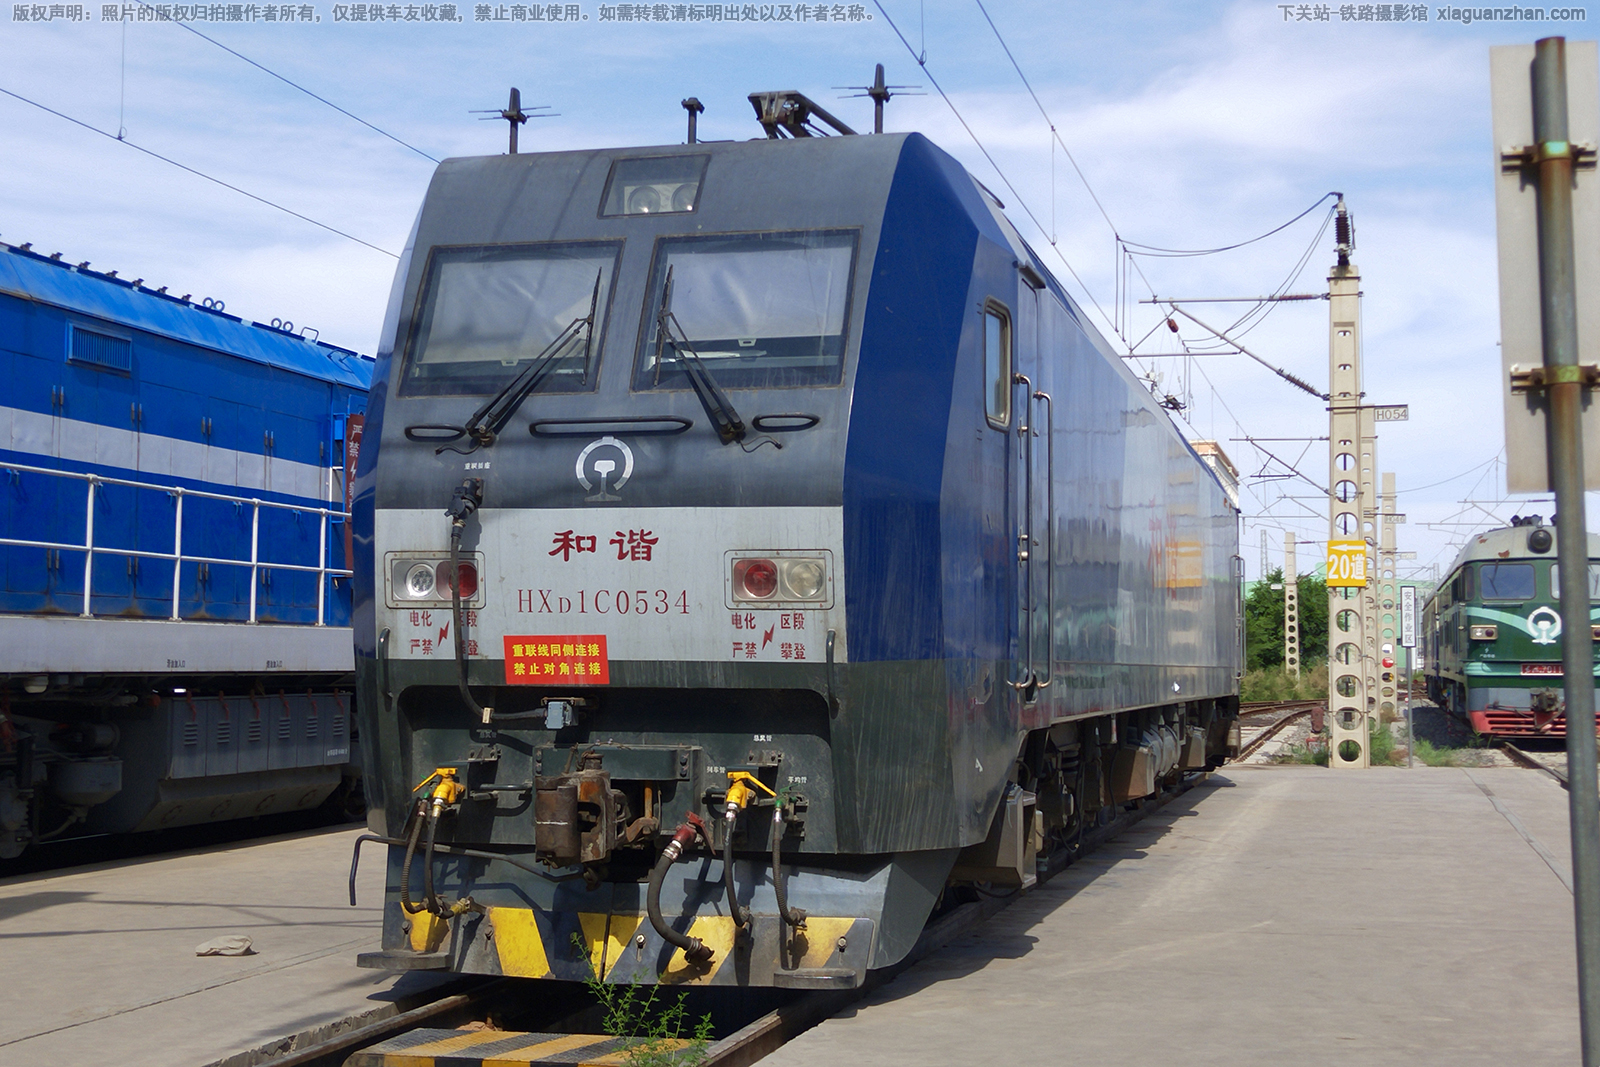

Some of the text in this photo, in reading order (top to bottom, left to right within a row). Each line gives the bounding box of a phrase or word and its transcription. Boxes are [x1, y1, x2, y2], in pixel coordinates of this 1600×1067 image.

[1376, 409, 1408, 420] H054
[548, 528, 659, 562] 和谐
[1328, 553, 1365, 580] 20道
[517, 589, 690, 615] HXD1C0534
[409, 610, 432, 627] 电化
[732, 613, 805, 630] 电化 区段
[1404, 591, 1413, 644] 安全作业区
[409, 638, 433, 655] 严禁
[512, 643, 600, 657] 重联线同侧连接
[732, 642, 806, 660] 严禁 攀登
[513, 662, 601, 676] 禁止对角连接
